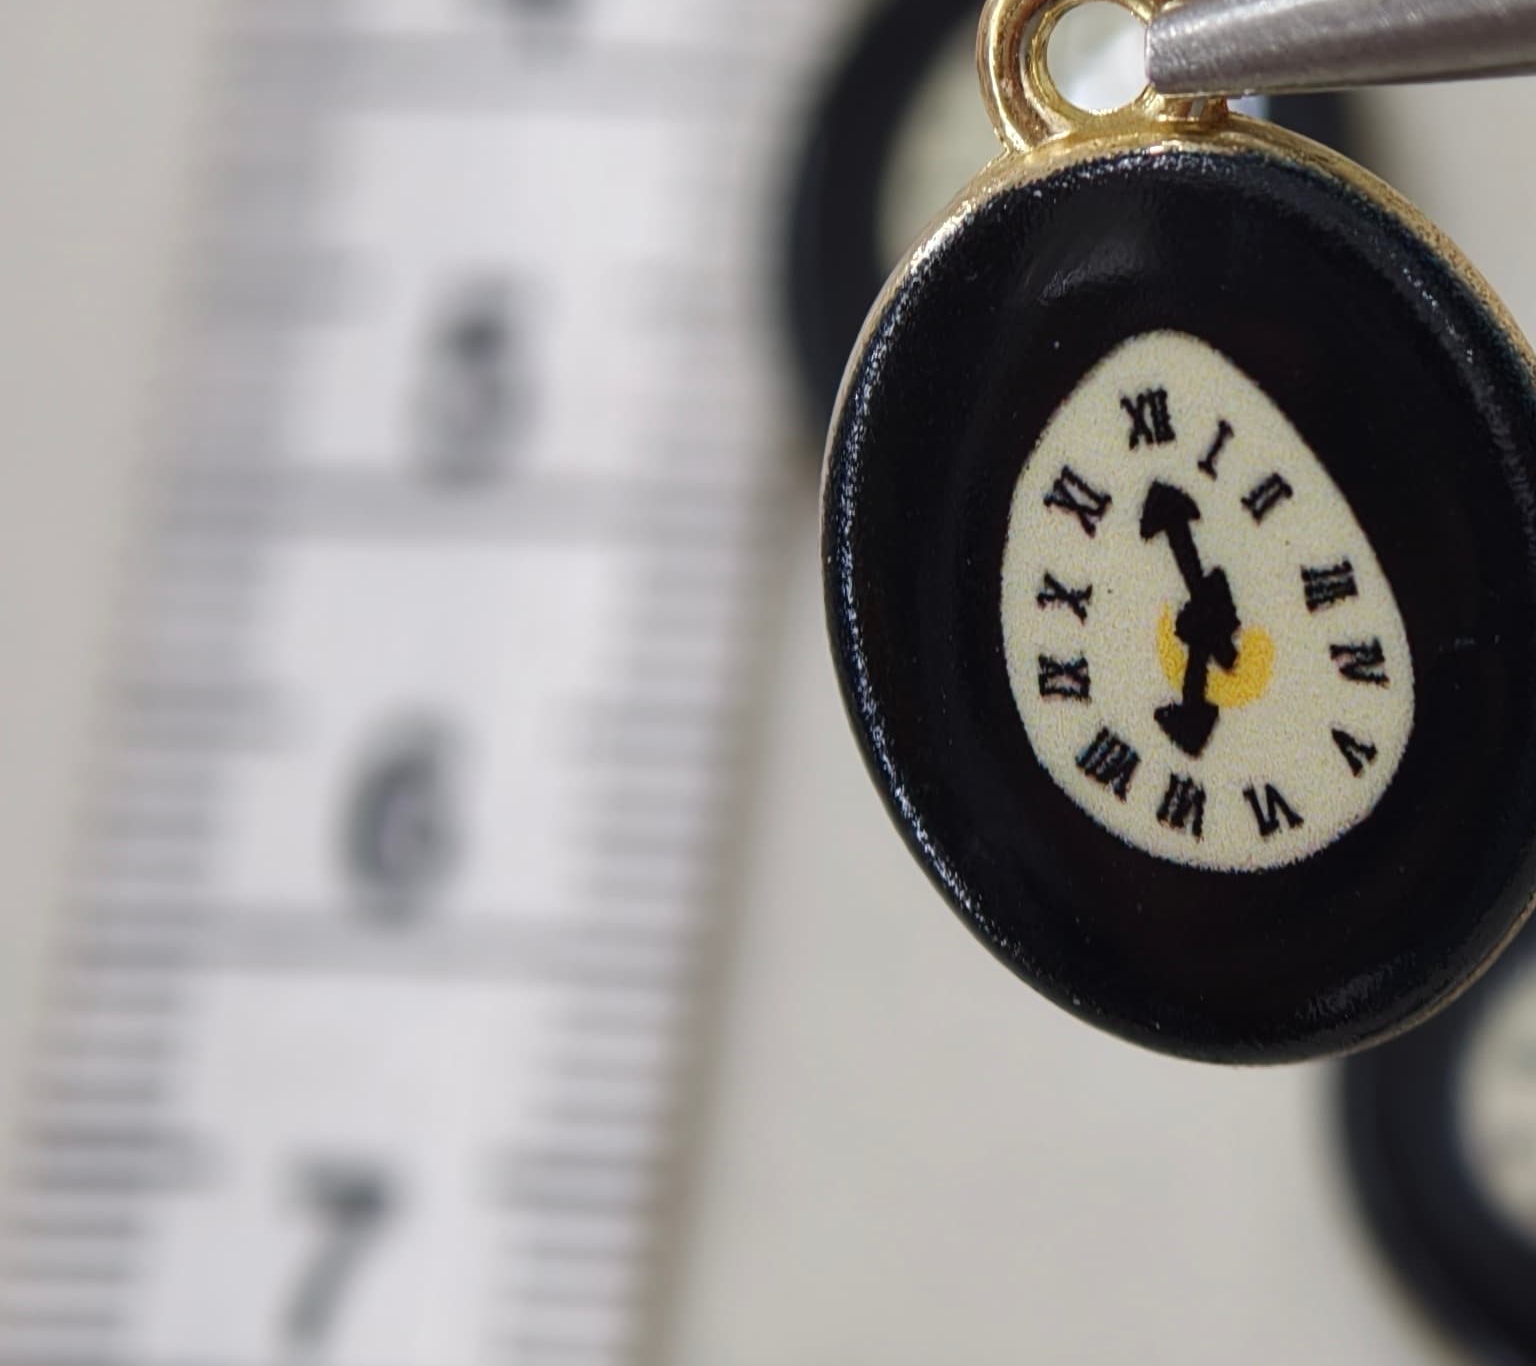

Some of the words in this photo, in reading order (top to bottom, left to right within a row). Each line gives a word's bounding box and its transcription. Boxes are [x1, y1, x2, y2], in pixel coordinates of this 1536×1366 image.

[1119, 386, 1177, 451] XII
[1196, 418, 1235, 482] I
[1042, 464, 1113, 539] XI
[1240, 471, 1294, 526] II
[1036, 571, 1094, 626] X
[1299, 557, 1359, 615] III
[1037, 651, 1093, 705] IX
[1328, 637, 1391, 689] IV
[1074, 725, 1142, 803] VIII
[1330, 727, 1379, 779] V
[332, 705, 468, 925] 6
[1155, 771, 1208, 843] VII
[1241, 782, 1305, 843] VI
[280, 1145, 400, 1360] 7
